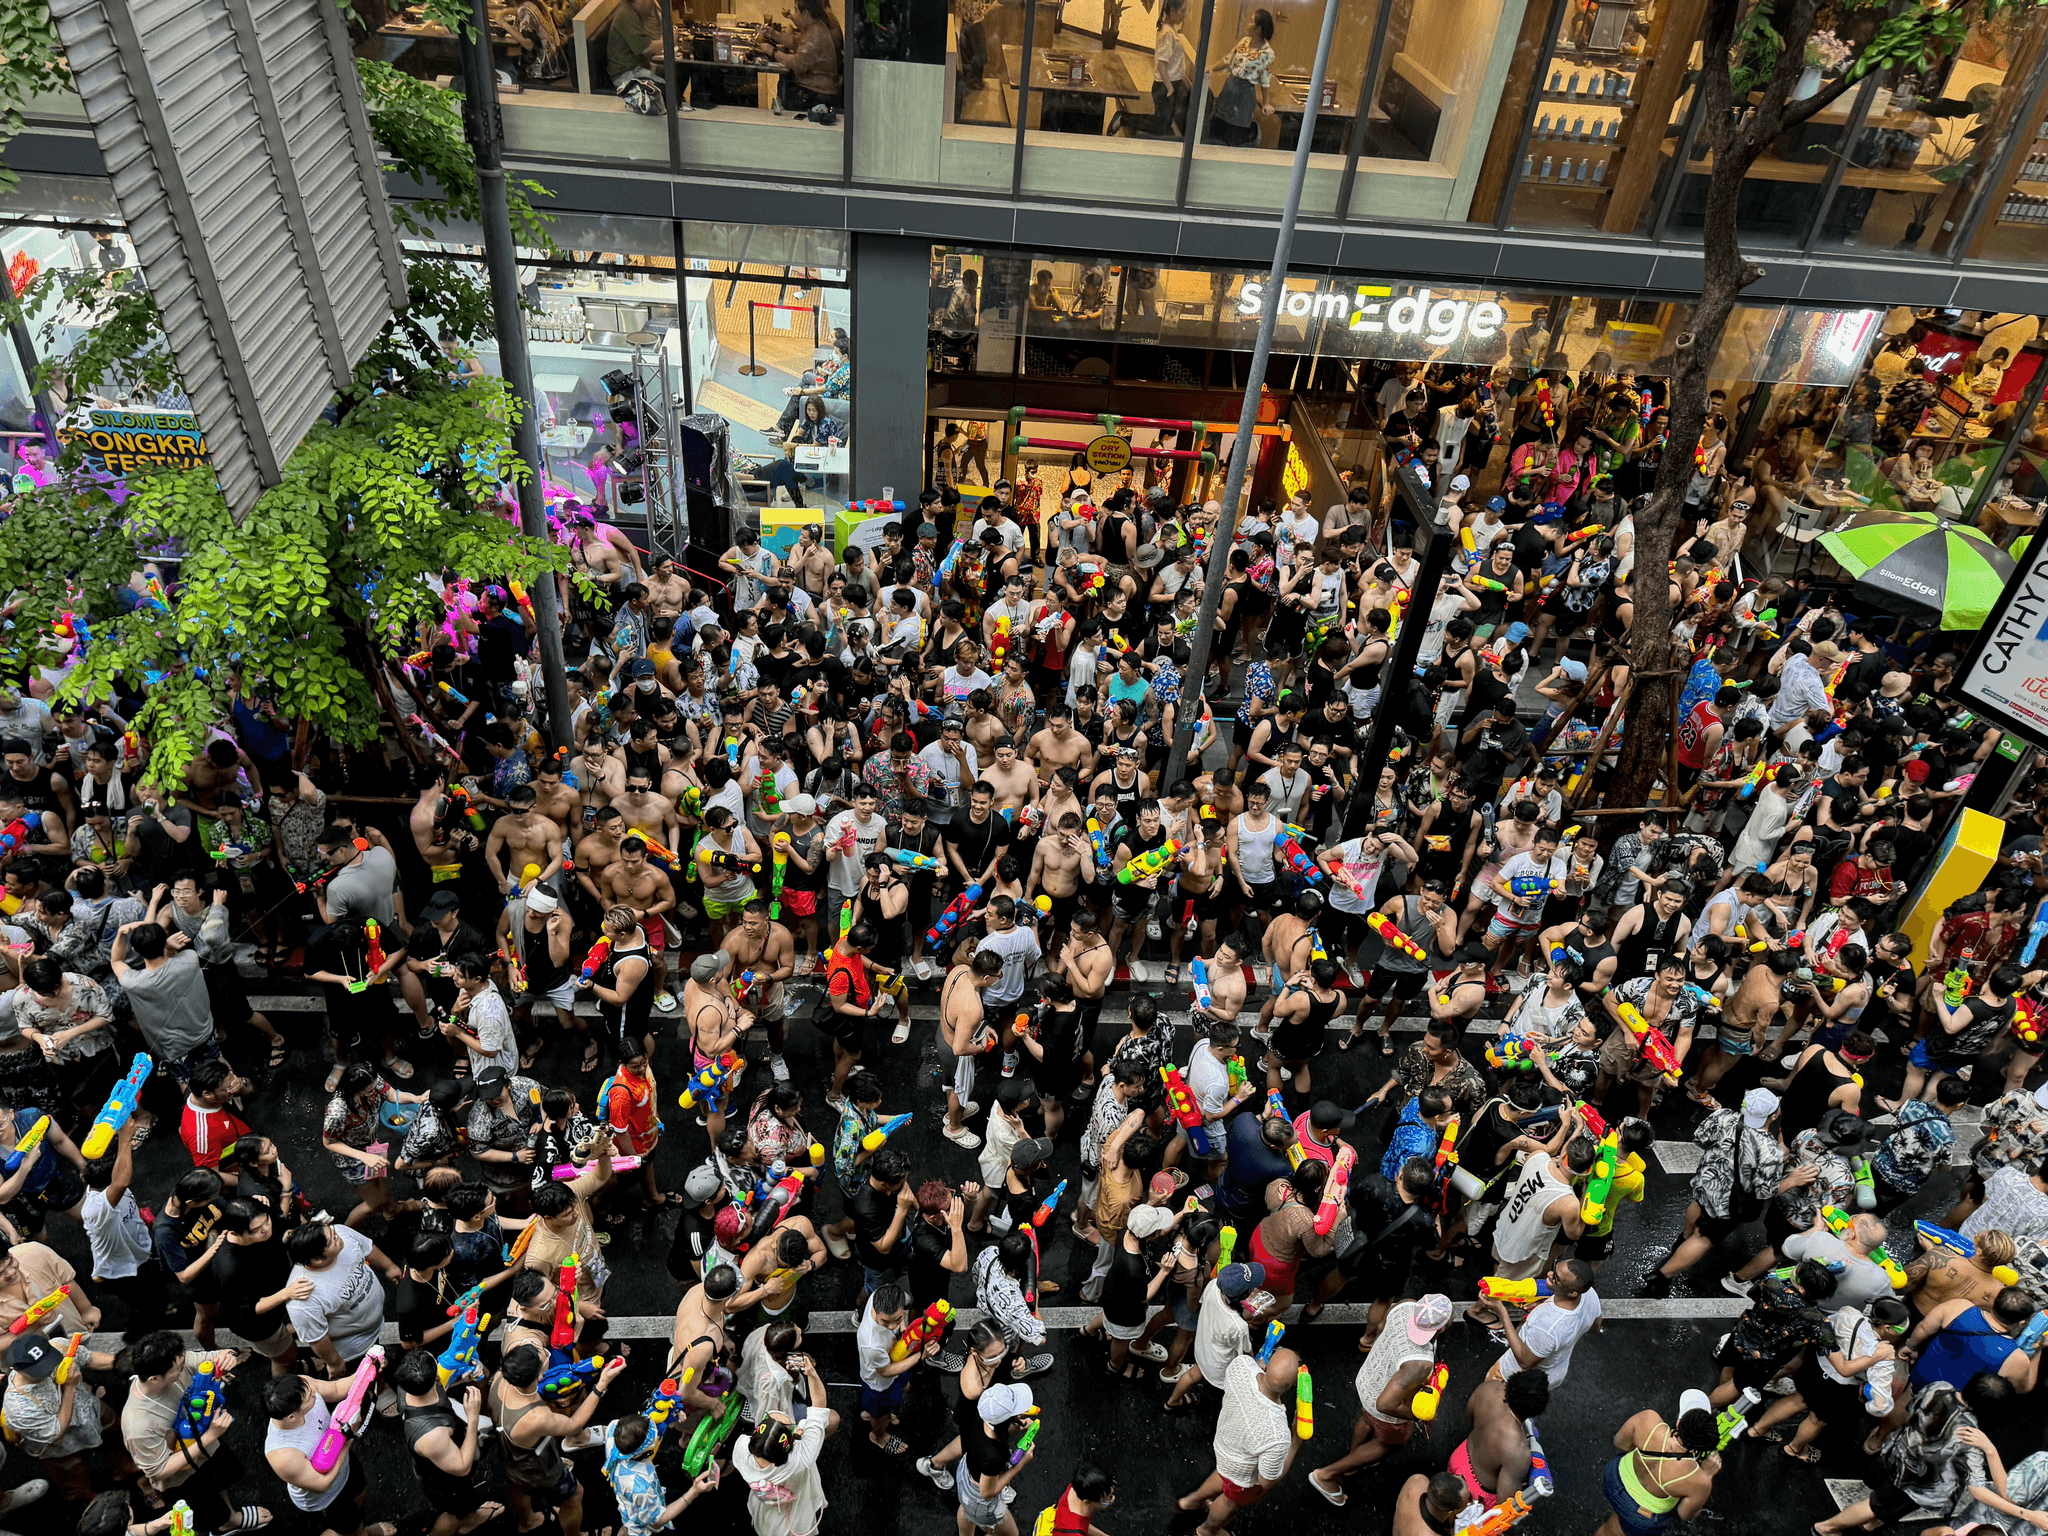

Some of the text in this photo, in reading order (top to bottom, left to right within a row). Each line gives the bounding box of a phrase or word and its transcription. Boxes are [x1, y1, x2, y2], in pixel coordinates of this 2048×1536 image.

[1237, 283, 1503, 345] SlomEdge
[91, 412, 154, 429] SILOM
[1092, 451, 1125, 460] STATION
[1100, 444, 1120, 452] DRY
[1982, 582, 2046, 675] CATHY
[1679, 719, 1698, 751] 23
[27, 1345, 44, 1361] B
